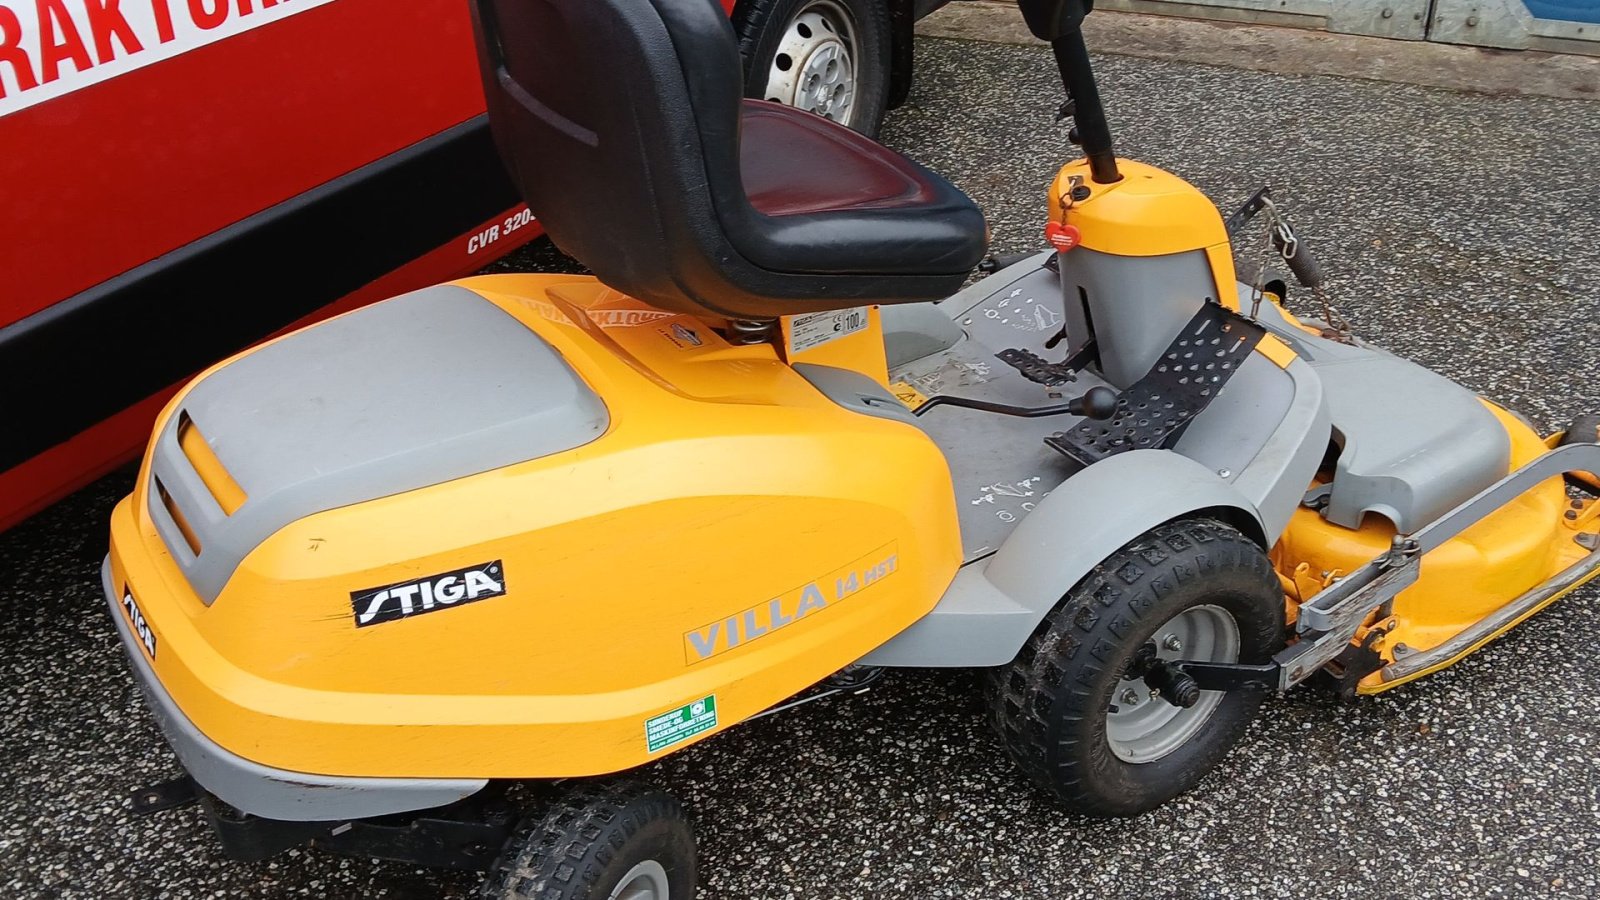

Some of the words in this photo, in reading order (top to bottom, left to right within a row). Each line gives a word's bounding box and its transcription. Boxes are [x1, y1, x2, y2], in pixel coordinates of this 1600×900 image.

[467, 224, 500, 255] CVR
[845, 312, 860, 330] 100
[123, 593, 155, 657] STIGA
[687, 582, 827, 659] VILLA
[834, 571, 859, 600] 14
[863, 554, 898, 586] HST
